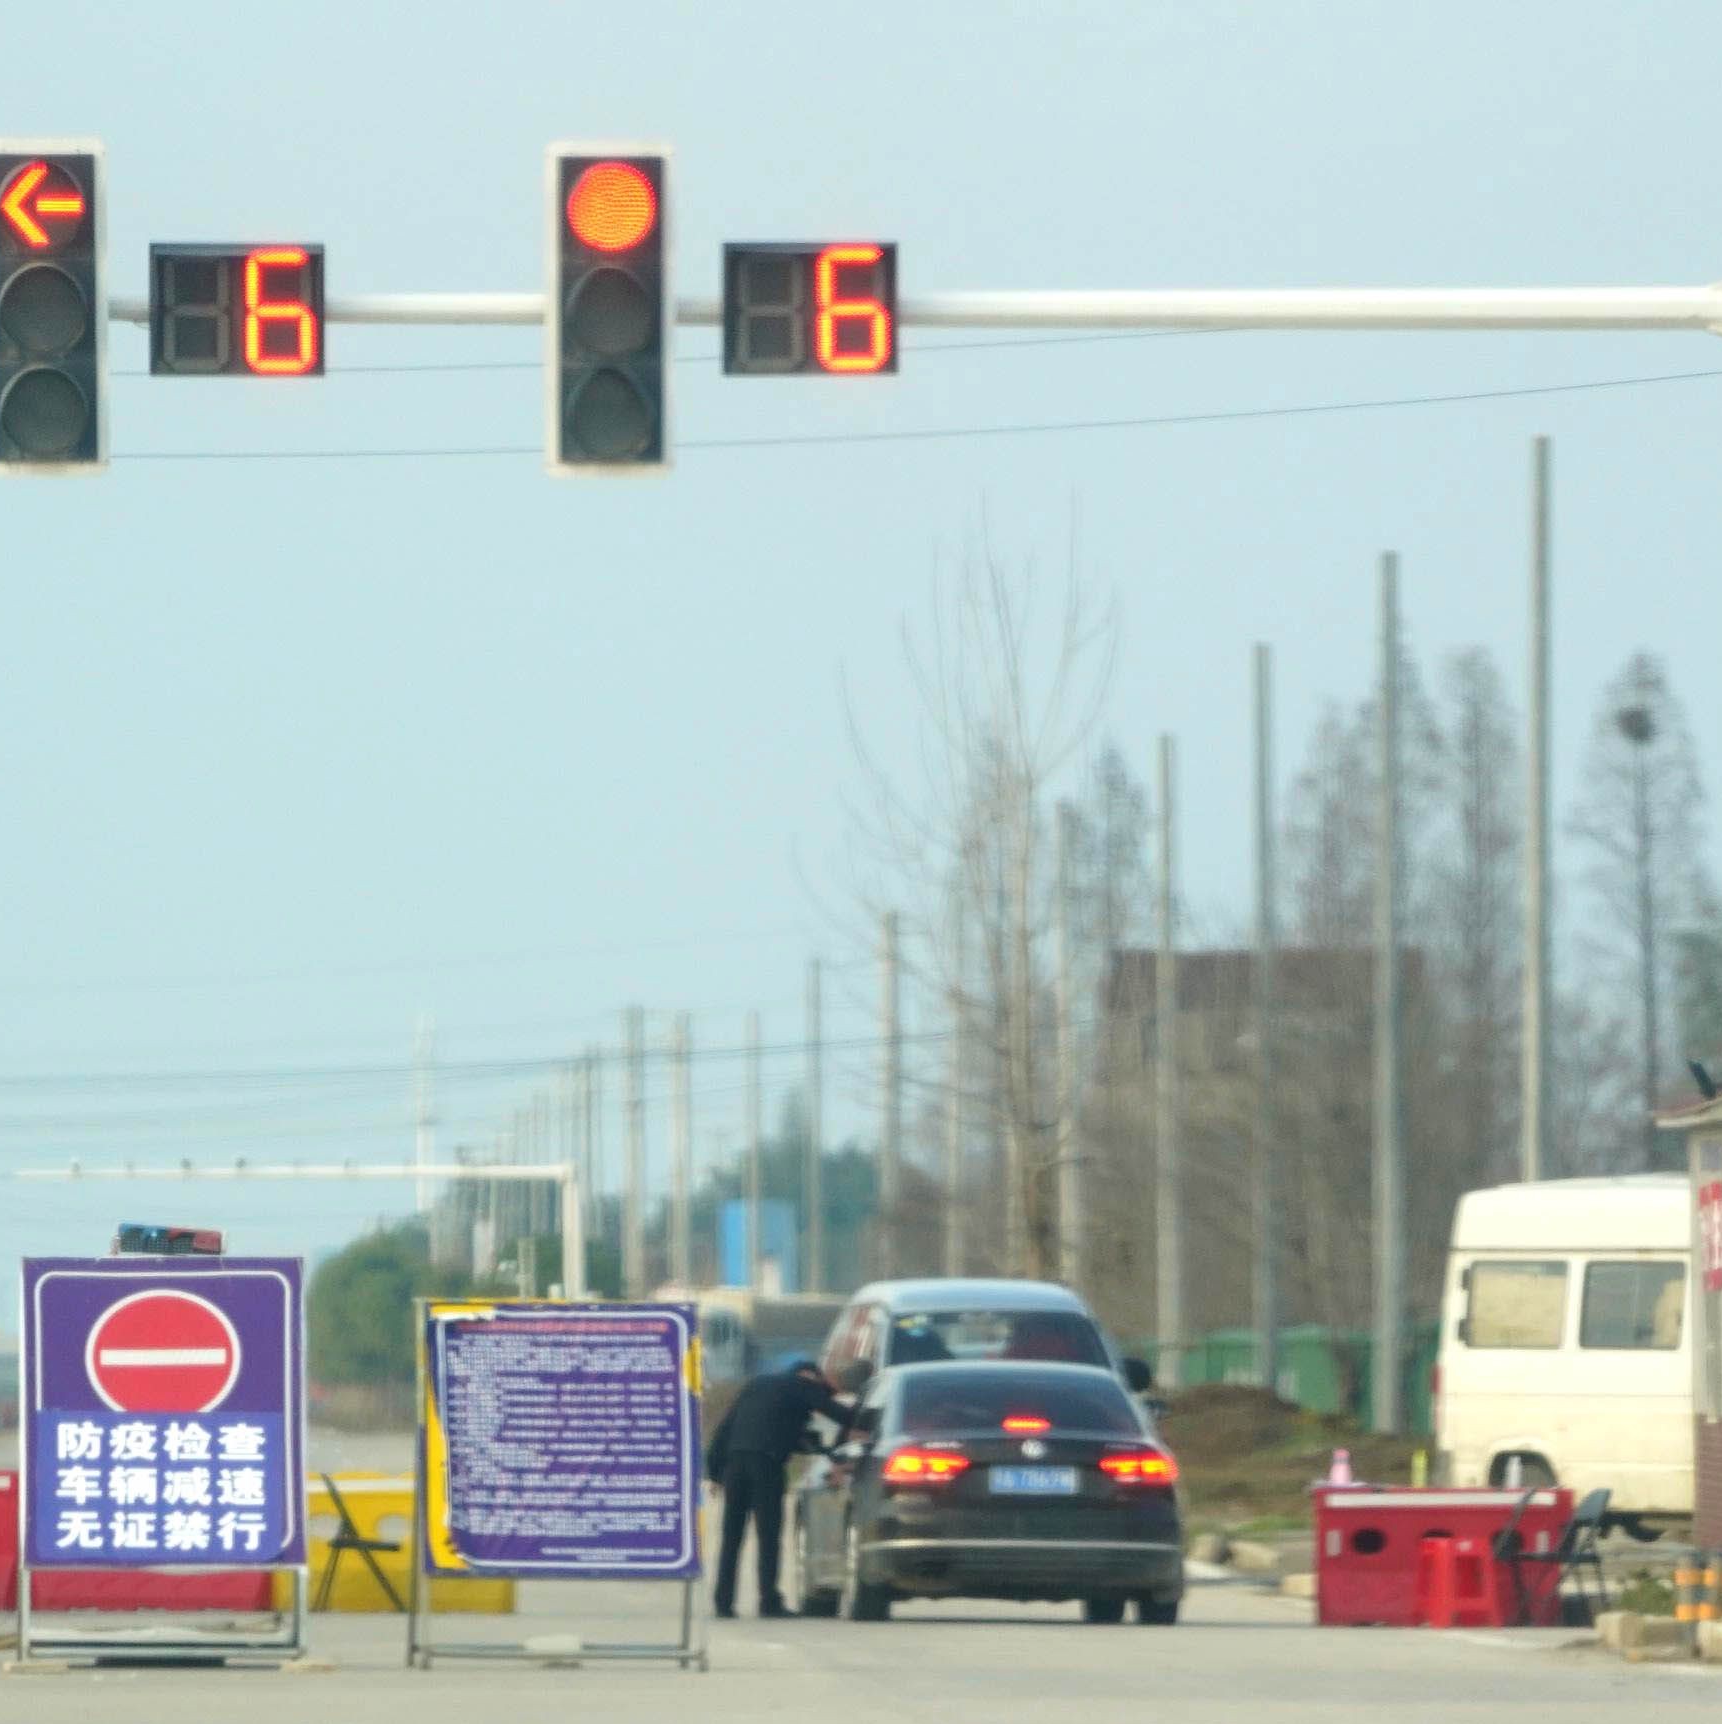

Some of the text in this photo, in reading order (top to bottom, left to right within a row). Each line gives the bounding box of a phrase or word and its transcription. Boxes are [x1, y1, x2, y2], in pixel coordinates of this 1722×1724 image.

[243, 246, 317, 376] 6
[815, 243, 891, 374] 6
[56, 1421, 267, 1460] 防疫检查
[56, 1466, 266, 1505] 车辆减速
[56, 1511, 267, 1550] 无证禁行
